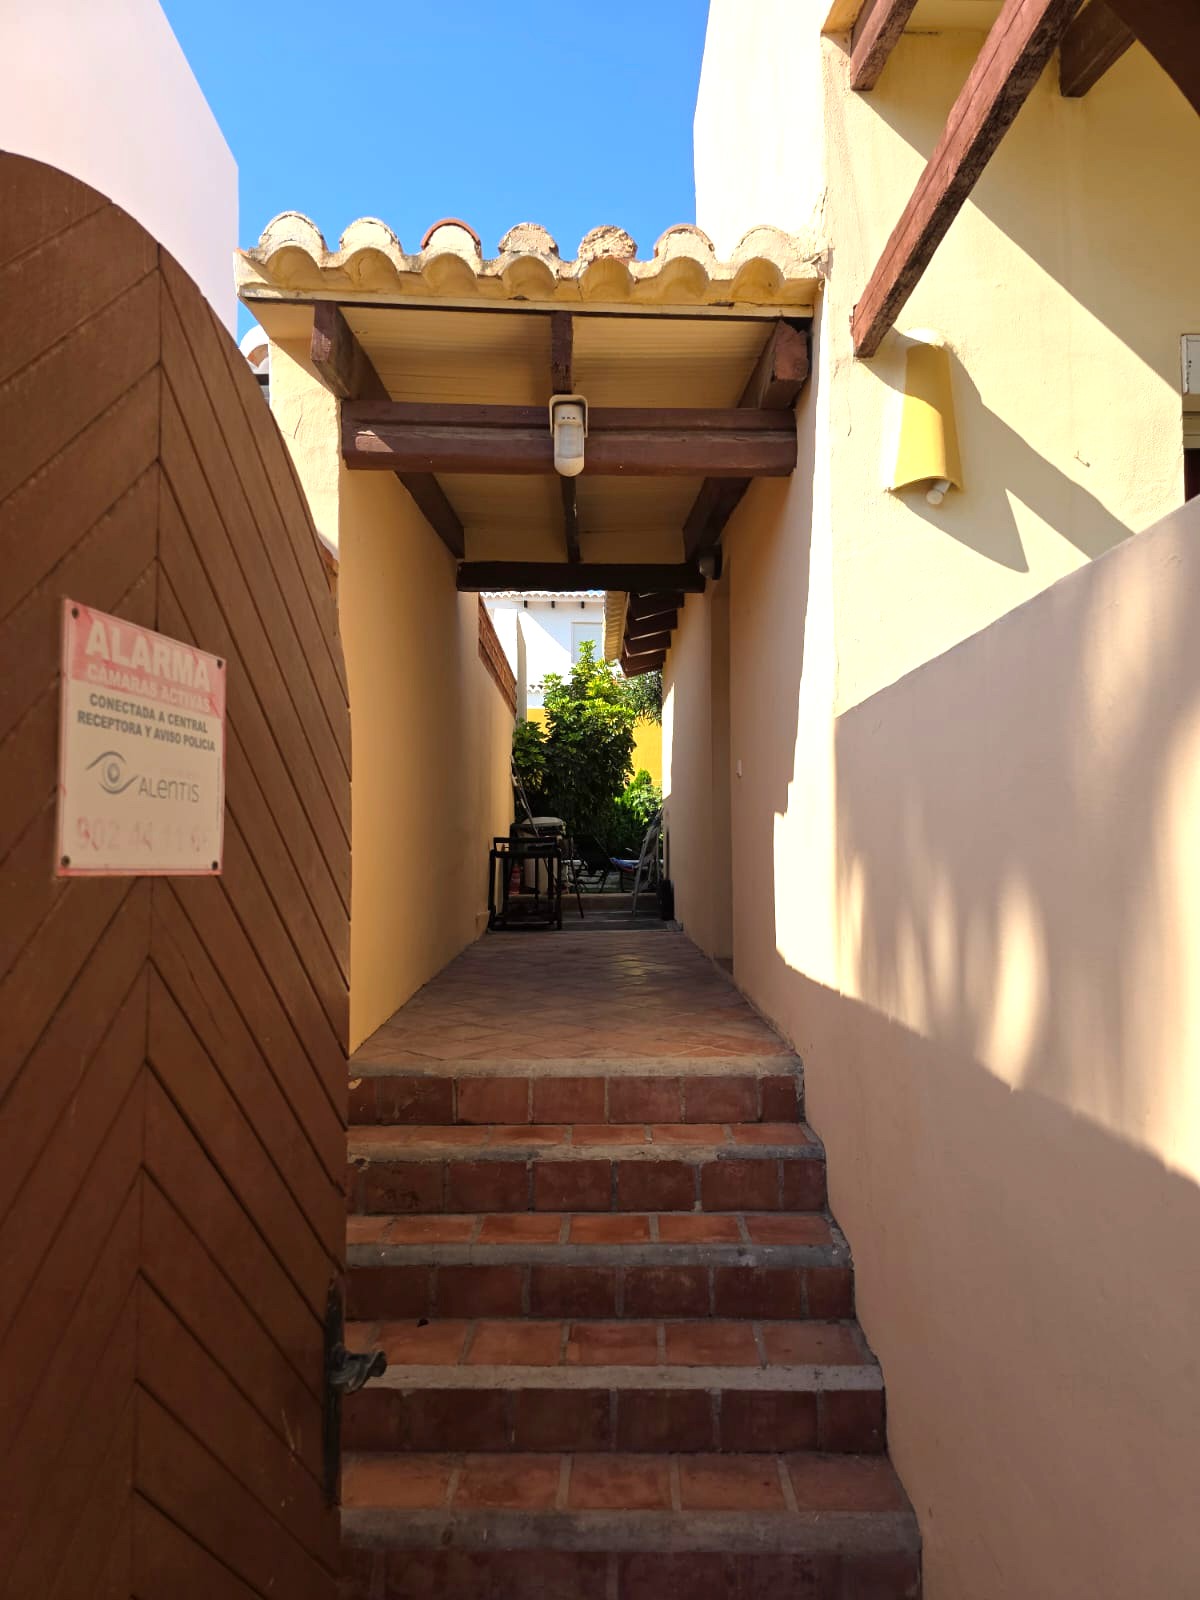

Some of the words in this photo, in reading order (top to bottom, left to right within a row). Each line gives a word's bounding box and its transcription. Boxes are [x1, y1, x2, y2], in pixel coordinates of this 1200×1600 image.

[86, 619, 211, 692] ALARMA
[77, 710, 143, 737] RECEPTORA
[144, 725, 152, 737] Y
[153, 727, 182, 745] AVISO
[183, 734, 216, 752] POLICIA
[89, 693, 156, 720] CONECTADA
[158, 711, 166, 723] A
[168, 713, 208, 734] CENTRAL
